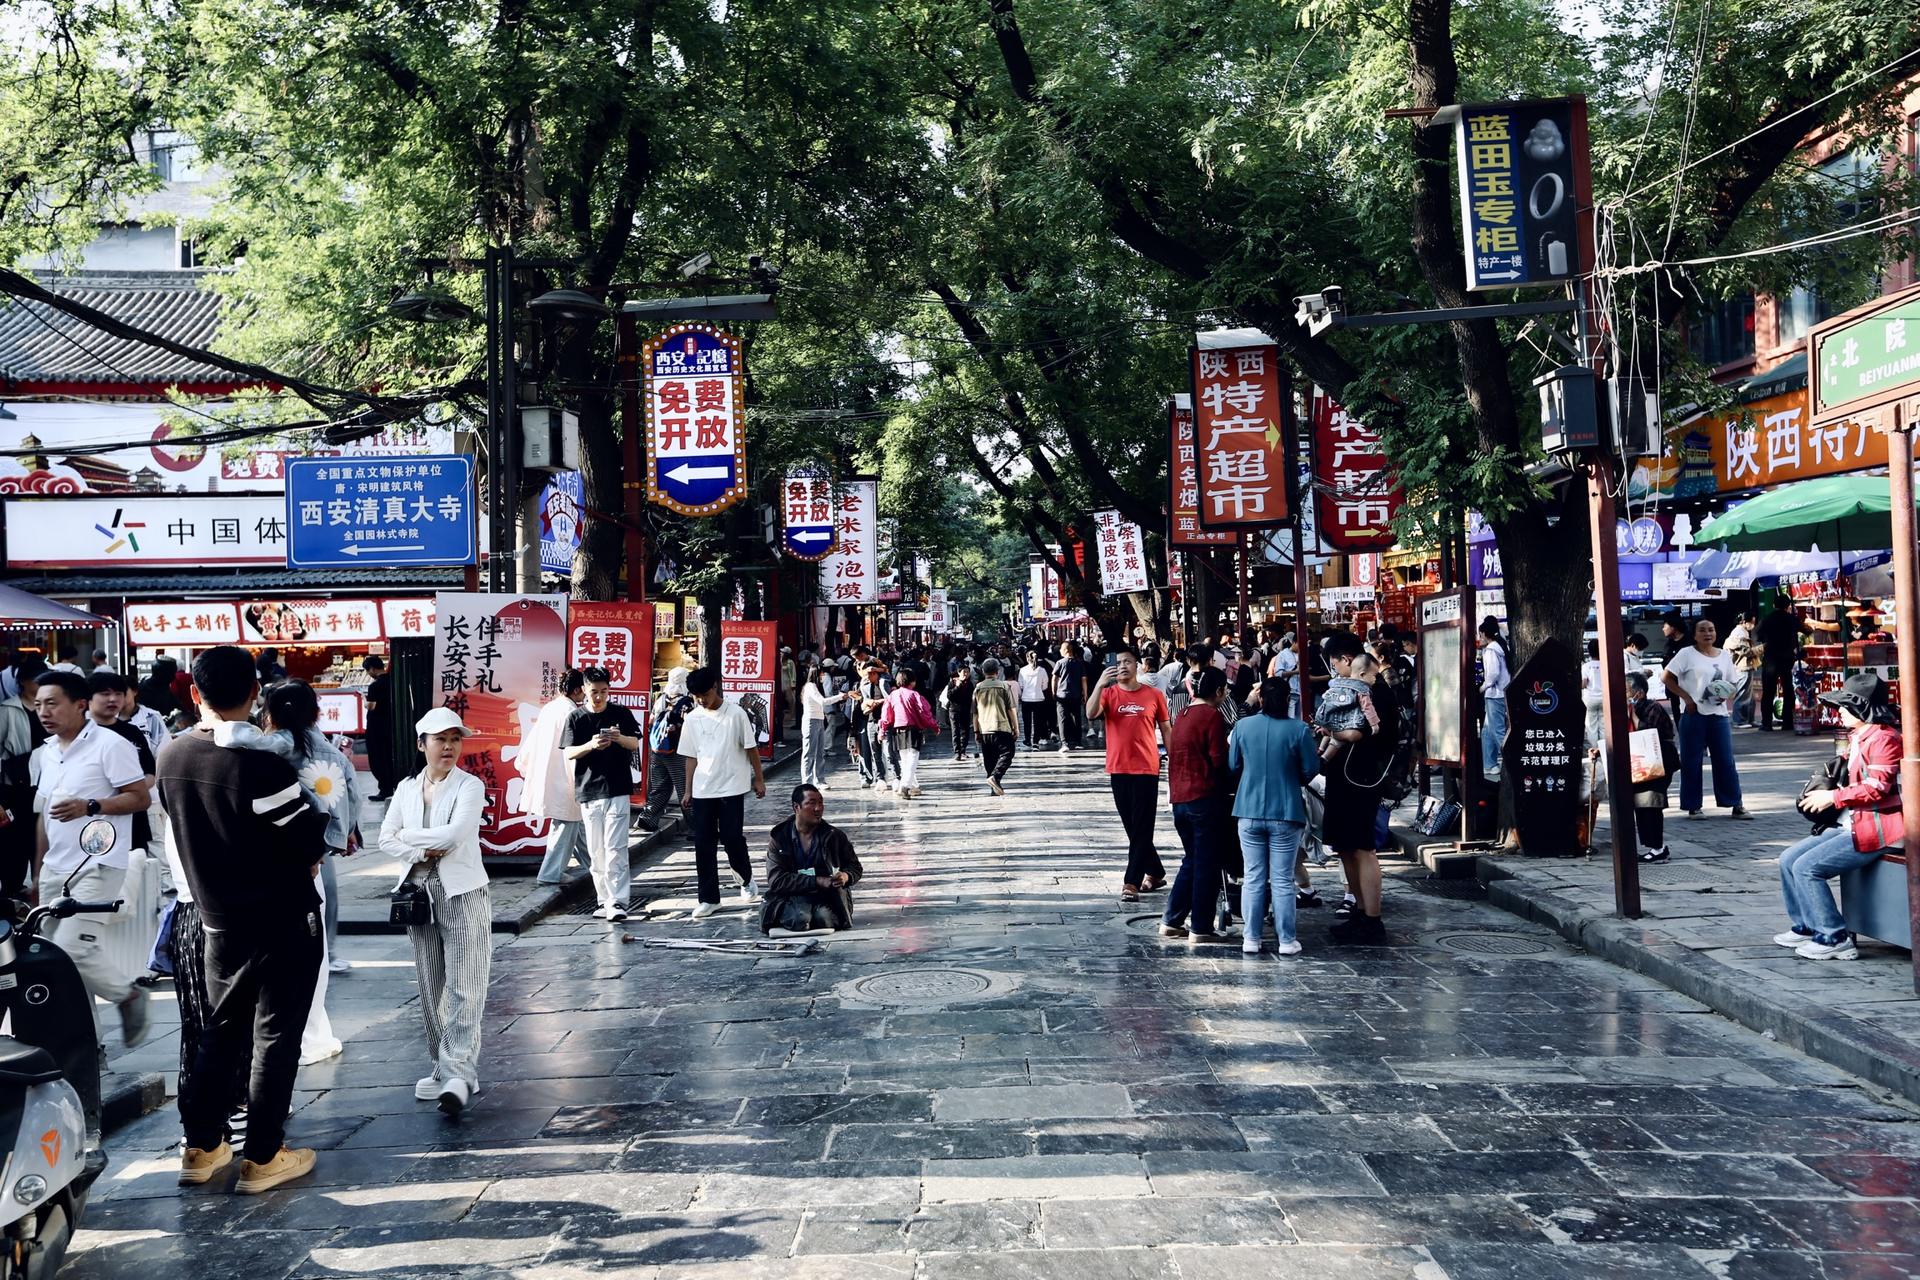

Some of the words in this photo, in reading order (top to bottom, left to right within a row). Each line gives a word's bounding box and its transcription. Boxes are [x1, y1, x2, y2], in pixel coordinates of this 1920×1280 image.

[1468, 114, 1519, 254] 蓝田玉专柜
[1477, 255, 1523, 269] 特产一楼
[656, 352, 686, 366] 西安
[696, 348, 727, 365] 記憶
[1199, 350, 1265, 379] 陕西
[659, 380, 726, 414] 免费
[659, 416, 728, 450] 开放
[1201, 381, 1272, 519] 特产超市
[316, 465, 443, 480] 全国重点文物保护单位
[1330, 410, 1390, 526] 特产超市
[787, 480, 830, 501] 免费
[299, 494, 463, 527] 西安清真大寺
[789, 502, 830, 523] 开放
[167, 516, 285, 546] 中国体
[343, 528, 420, 541] 全国园林式寺院
[1186, 532, 1226, 540] 正品专柜
[833, 495, 865, 600] 老米家泡馍
[1099, 513, 1120, 573] 非遗皮影
[1105, 578, 1145, 590] 请上二楼
[132, 613, 232, 633] 纯手工制作
[259, 611, 365, 633] 黄桂柿子饼
[473, 614, 504, 693] 伴手礼
[578, 631, 626, 656] 免费
[725, 641, 758, 657] 免费
[441, 614, 472, 718] 长安酥饼
[725, 659, 758, 675] 开放
[736, 682, 772, 692] OPENING
[1525, 729, 1565, 739] 您已进入
[1525, 742, 1565, 752] 垃圾分类
[1520, 755, 1570, 766] 示范管理区
